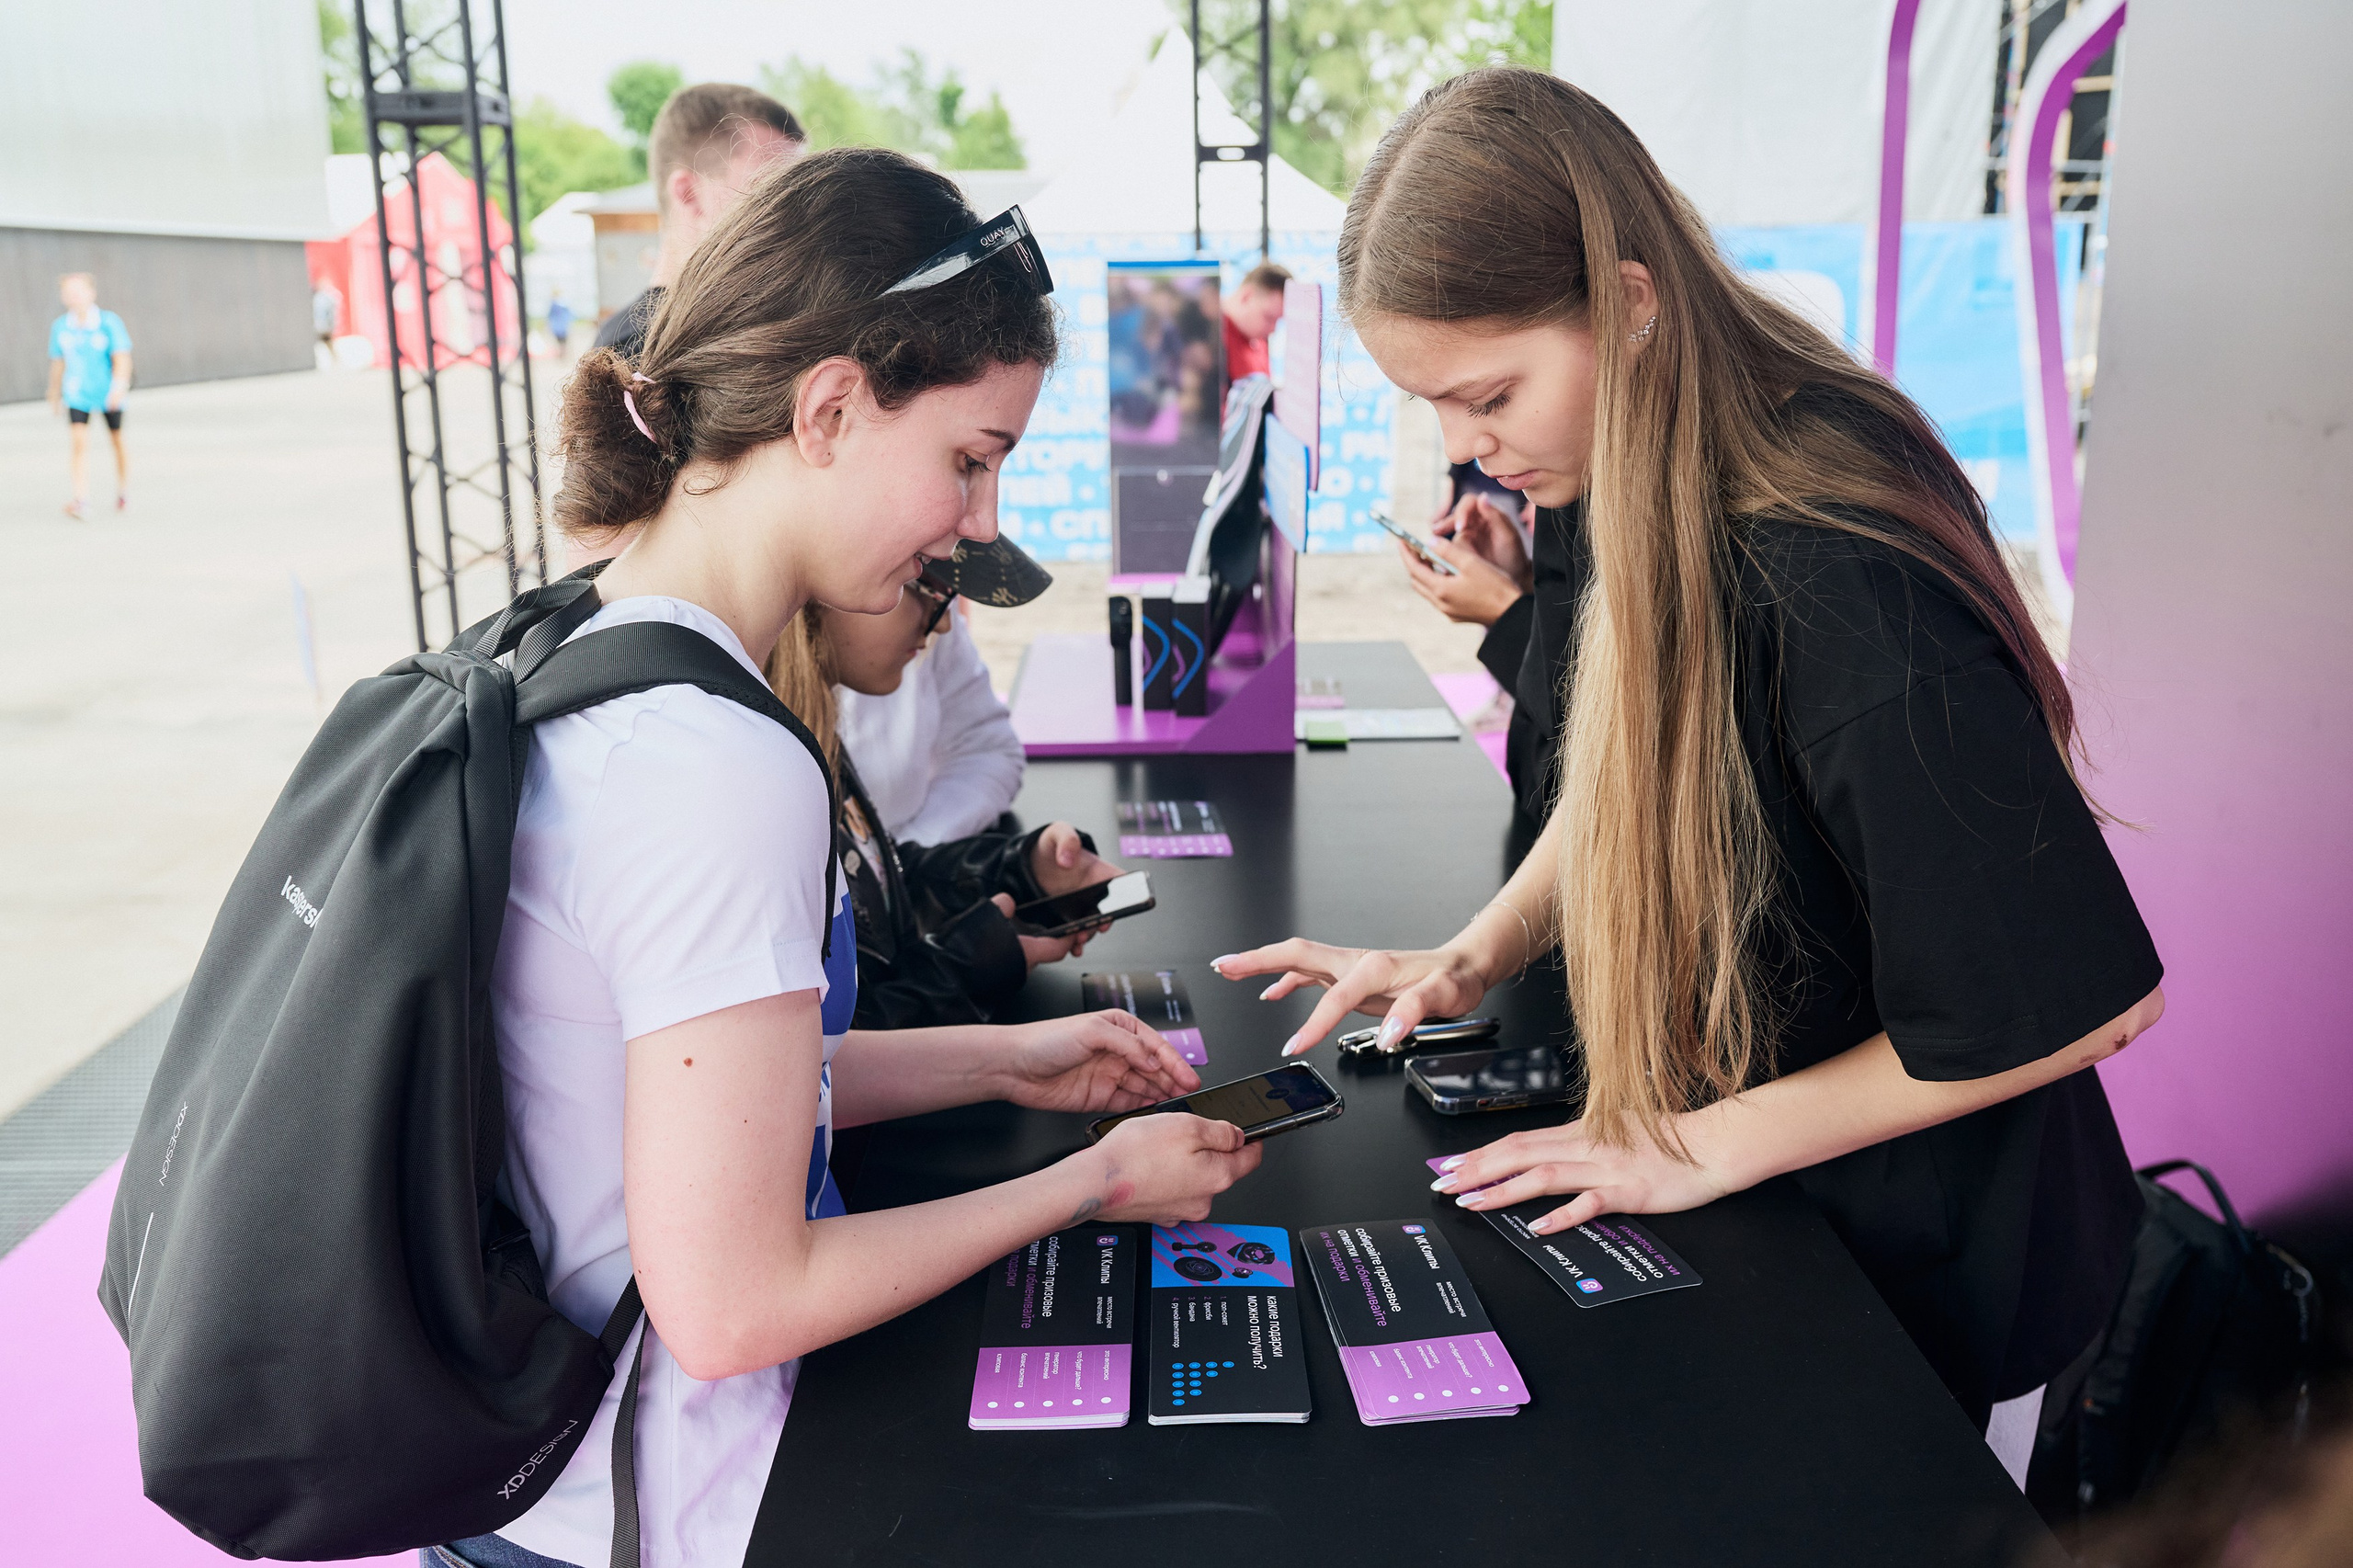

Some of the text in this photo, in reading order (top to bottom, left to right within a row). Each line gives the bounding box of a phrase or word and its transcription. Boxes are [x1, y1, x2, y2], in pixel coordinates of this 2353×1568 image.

[980, 226, 1005, 246] QUAY
[1028, 1241, 1040, 1266] тметки
[1100, 1248, 1113, 1284] VK Клипы
[1319, 1231, 1350, 1282] их на подарки
[1414, 1234, 1440, 1269] VK Клипы
[1543, 1244, 1584, 1278] VK Клипы
[1574, 1225, 1647, 1282] собирайте призо
[1619, 1225, 1680, 1276] их на подарки
[1624, 1244, 1664, 1278] отметки
[1006, 1255, 1018, 1287] подарки
[1042, 1236, 1061, 1317] собирайте призовые
[1337, 1229, 1359, 1257] отметки
[1355, 1264, 1387, 1327] обменивайте
[1355, 1227, 1402, 1312] собирайте призовые
[1021, 1273, 1038, 1329] обменивайте
[1171, 1302, 1180, 1320] ручной
[1188, 1301, 1196, 1322] бандана
[1203, 1301, 1212, 1321] фрисби
[1446, 1281, 1467, 1317] место встречи
[1172, 1321, 1180, 1348] вентилятор
[1246, 1295, 1267, 1369] можно получить?
[1267, 1295, 1283, 1357] какие подарки
